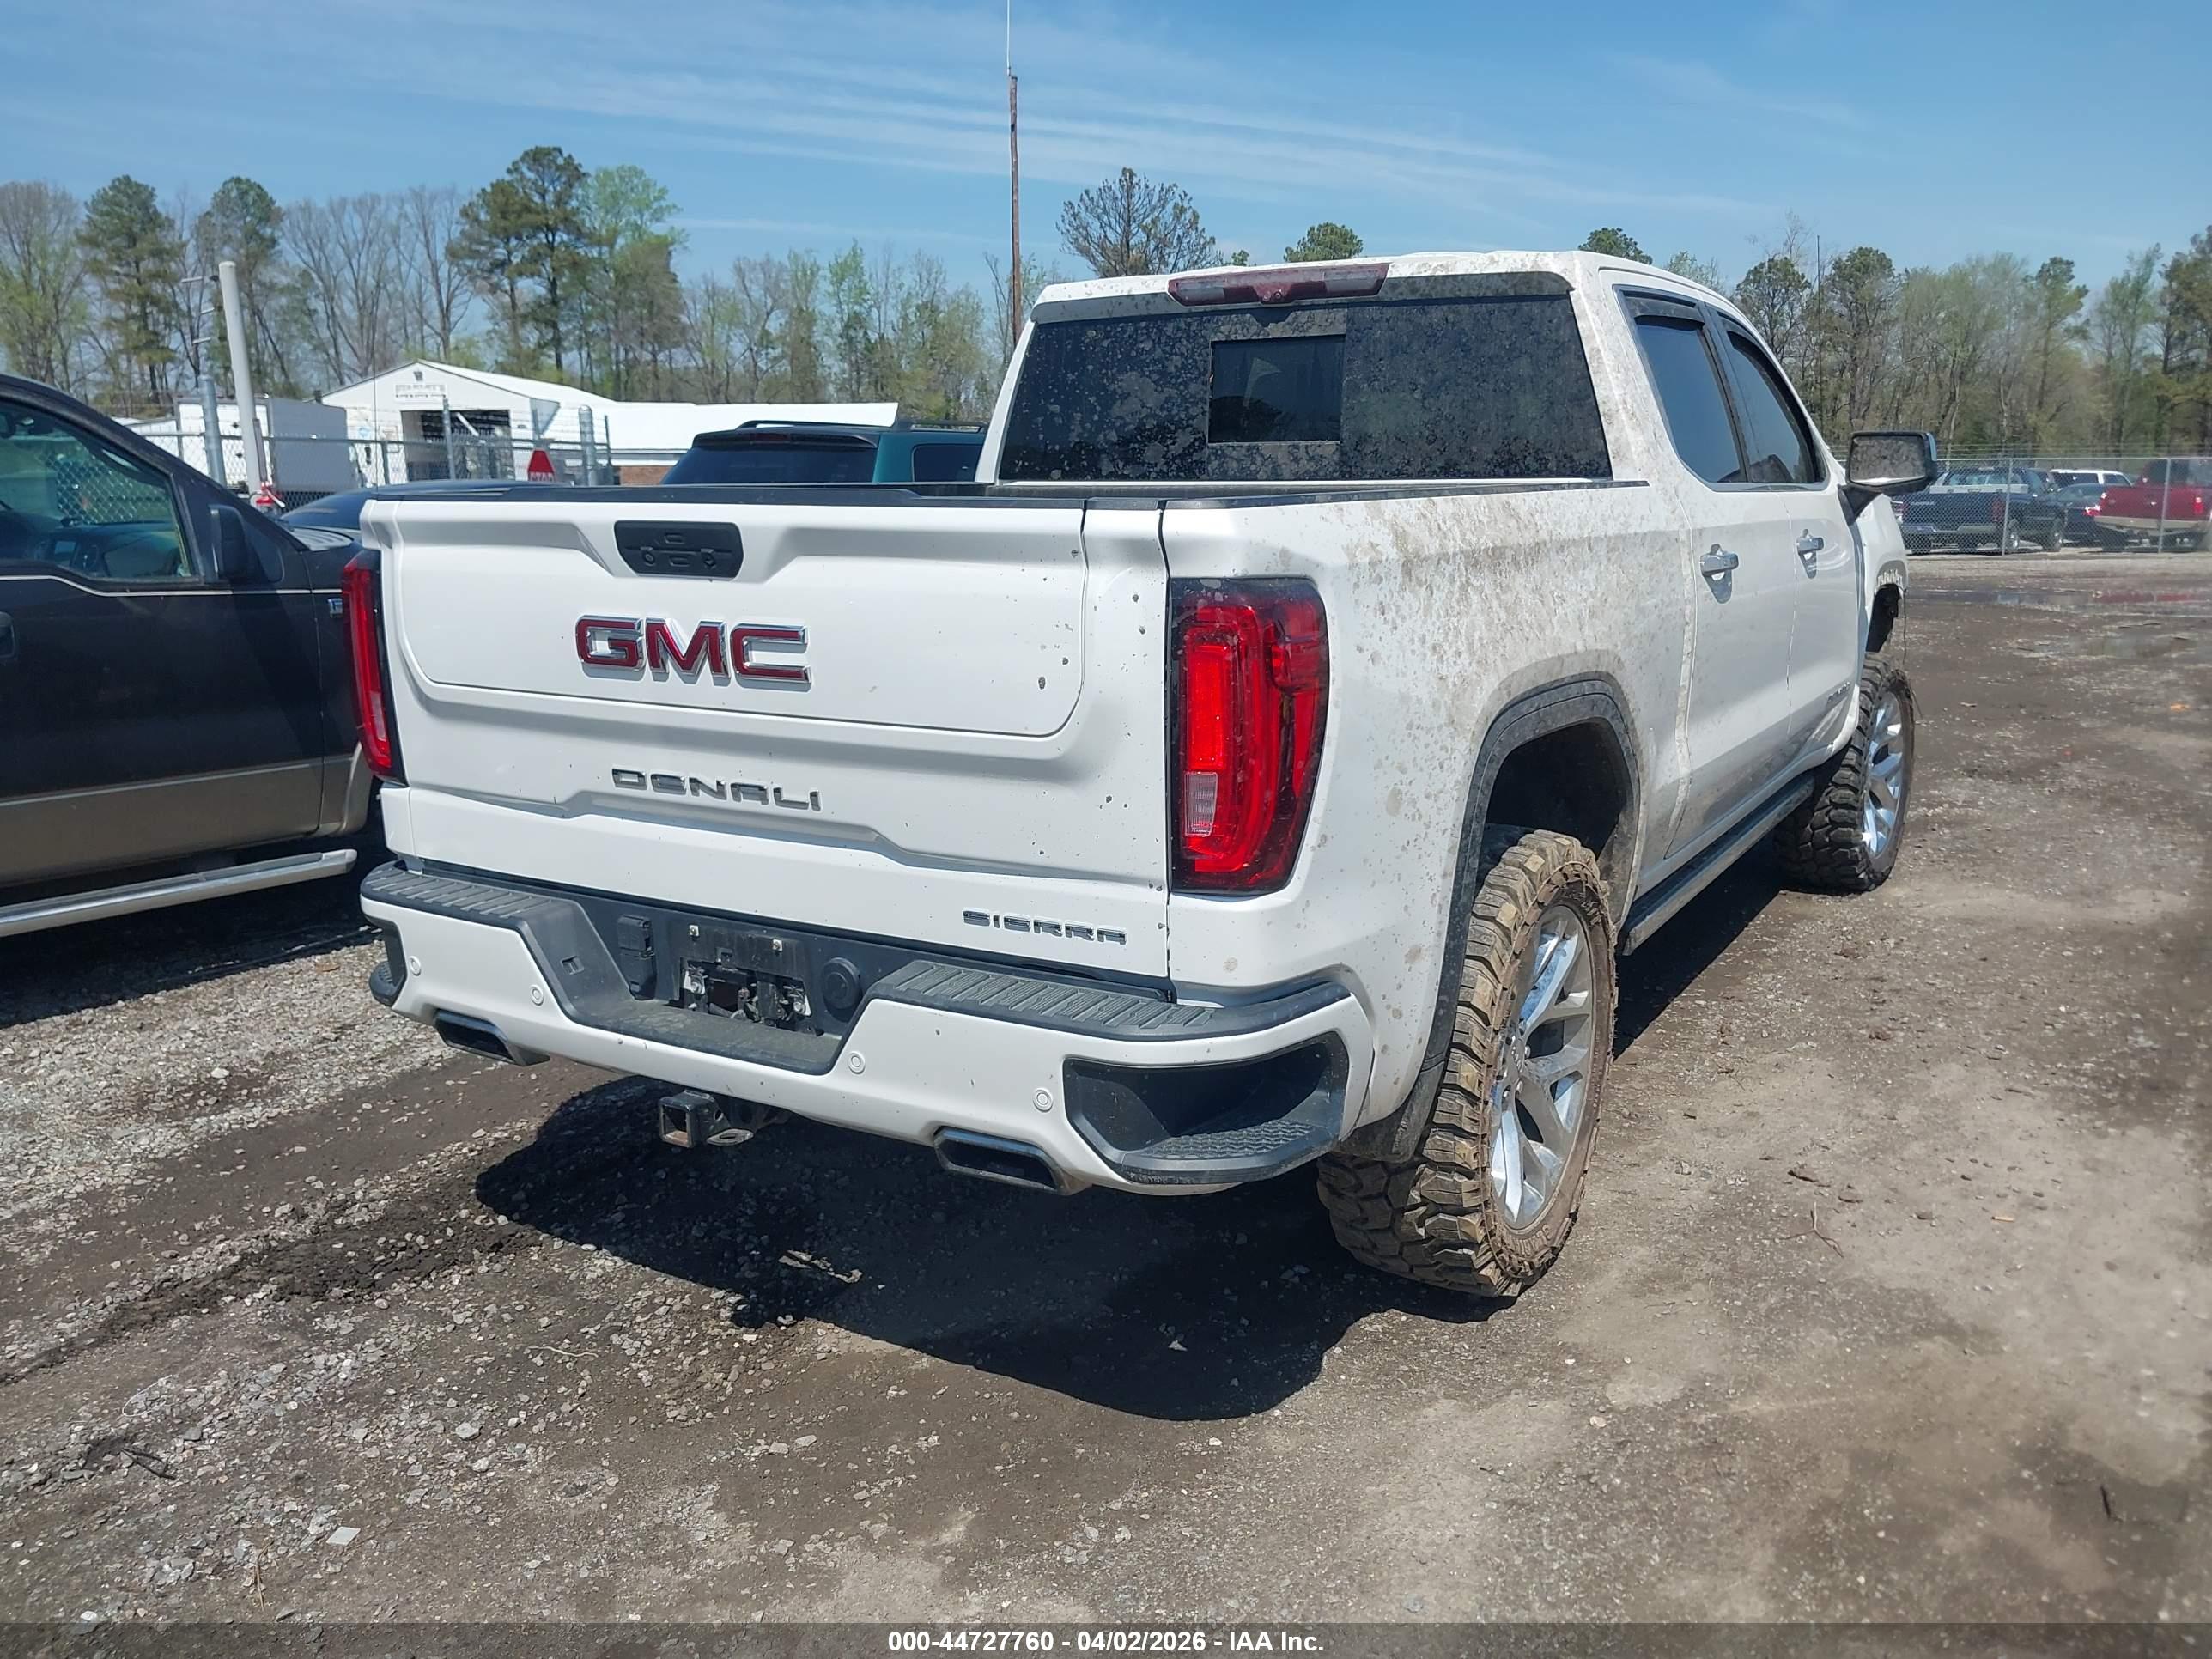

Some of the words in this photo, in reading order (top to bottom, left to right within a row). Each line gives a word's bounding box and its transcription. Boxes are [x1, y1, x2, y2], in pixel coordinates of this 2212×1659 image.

[575, 615, 811, 684] GMC
[611, 768, 822, 811] DENALI
[963, 909, 1127, 945] SIERRA
